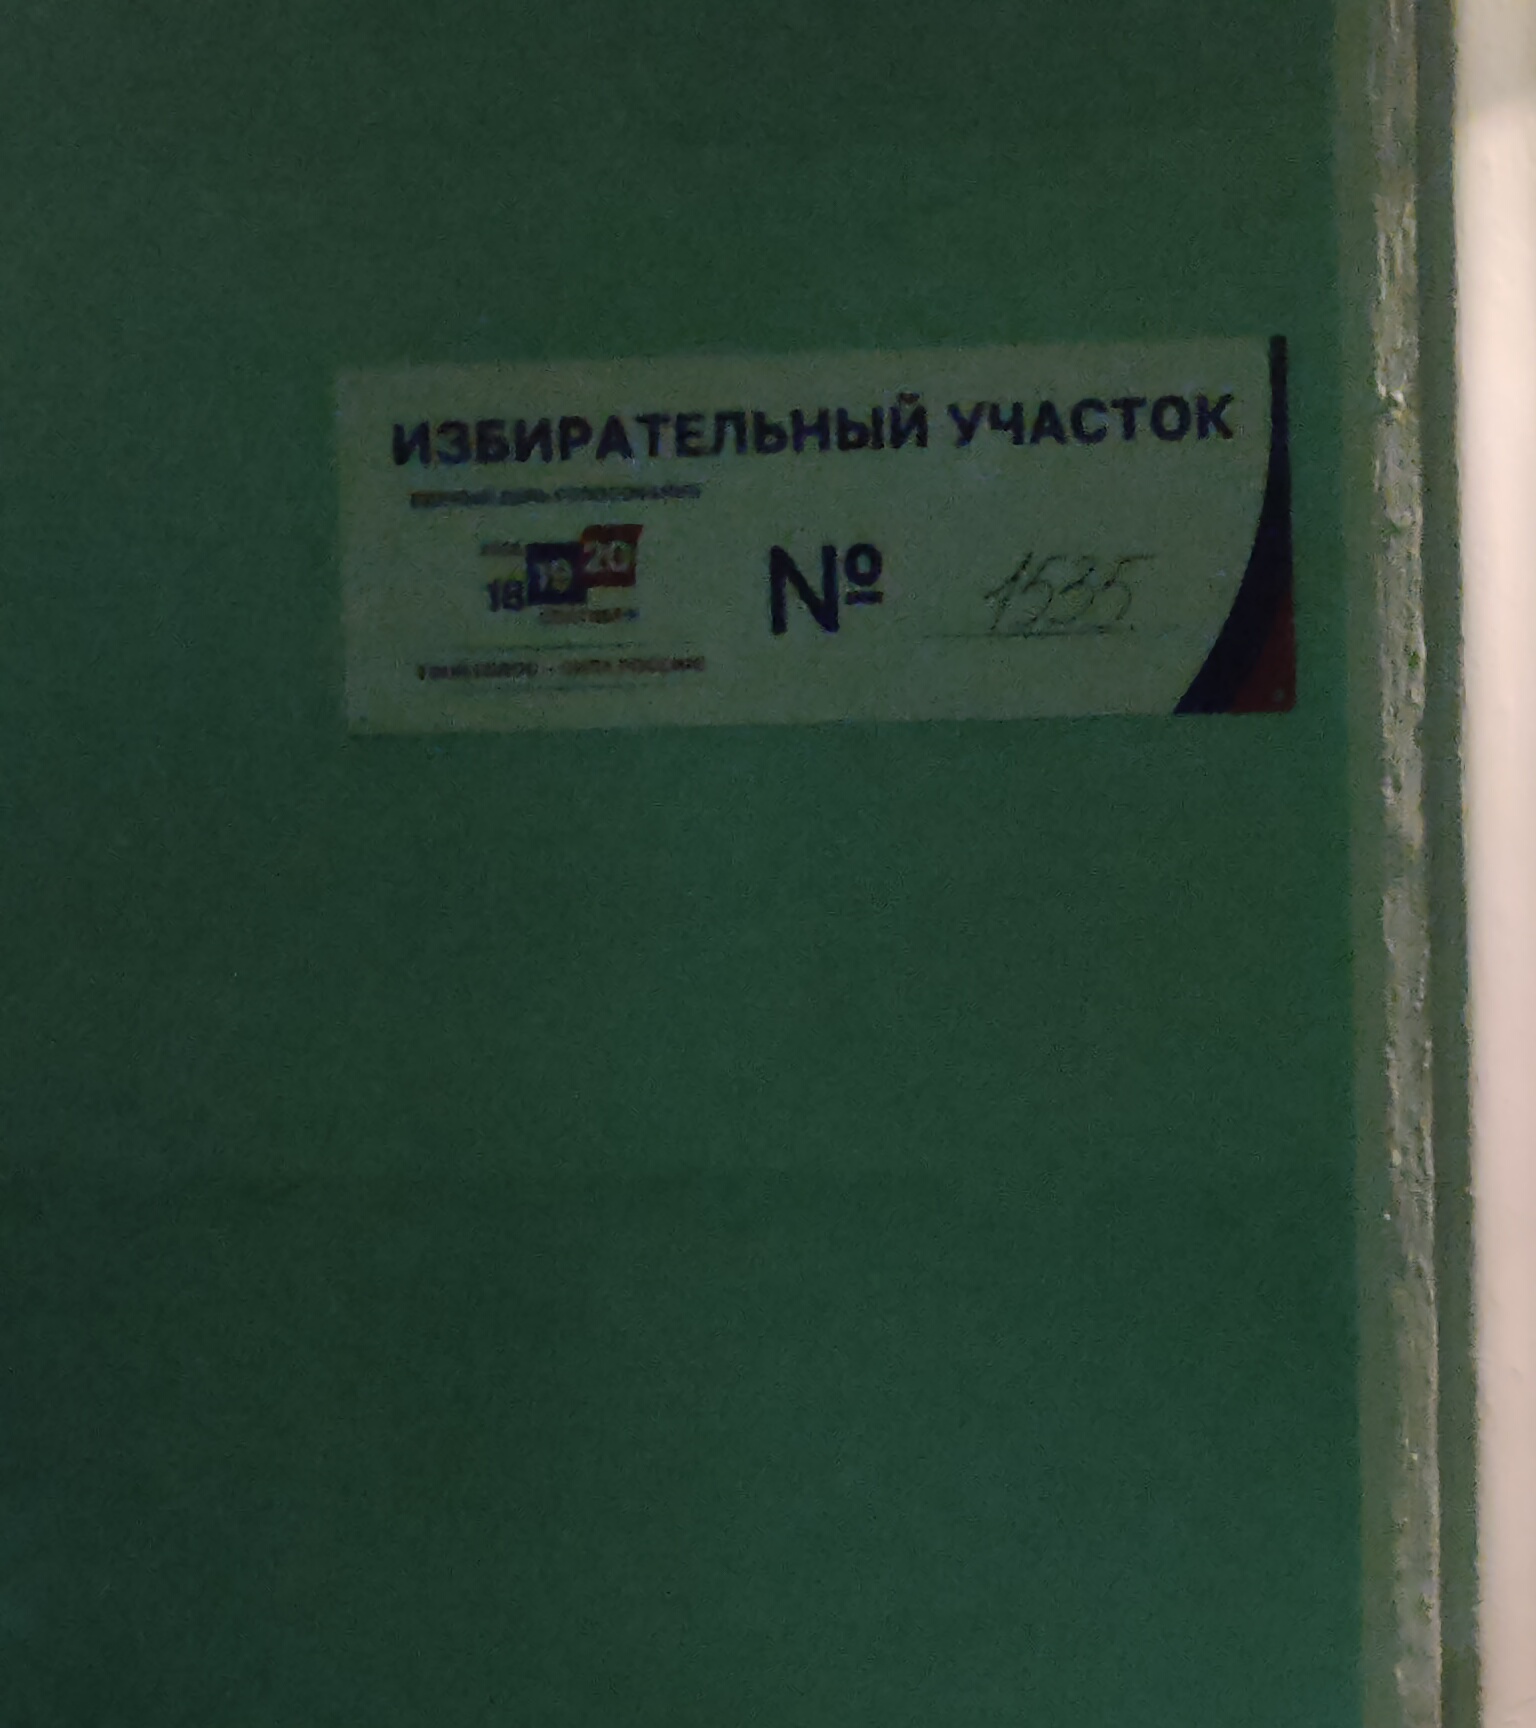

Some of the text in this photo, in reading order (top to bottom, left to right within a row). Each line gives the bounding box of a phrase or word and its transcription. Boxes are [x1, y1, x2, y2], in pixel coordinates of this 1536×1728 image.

[392, 392, 1235, 466] ИЗБИРАТЕЛЬНЫЙ УЧАСТОК
[584, 539, 633, 573] 20
